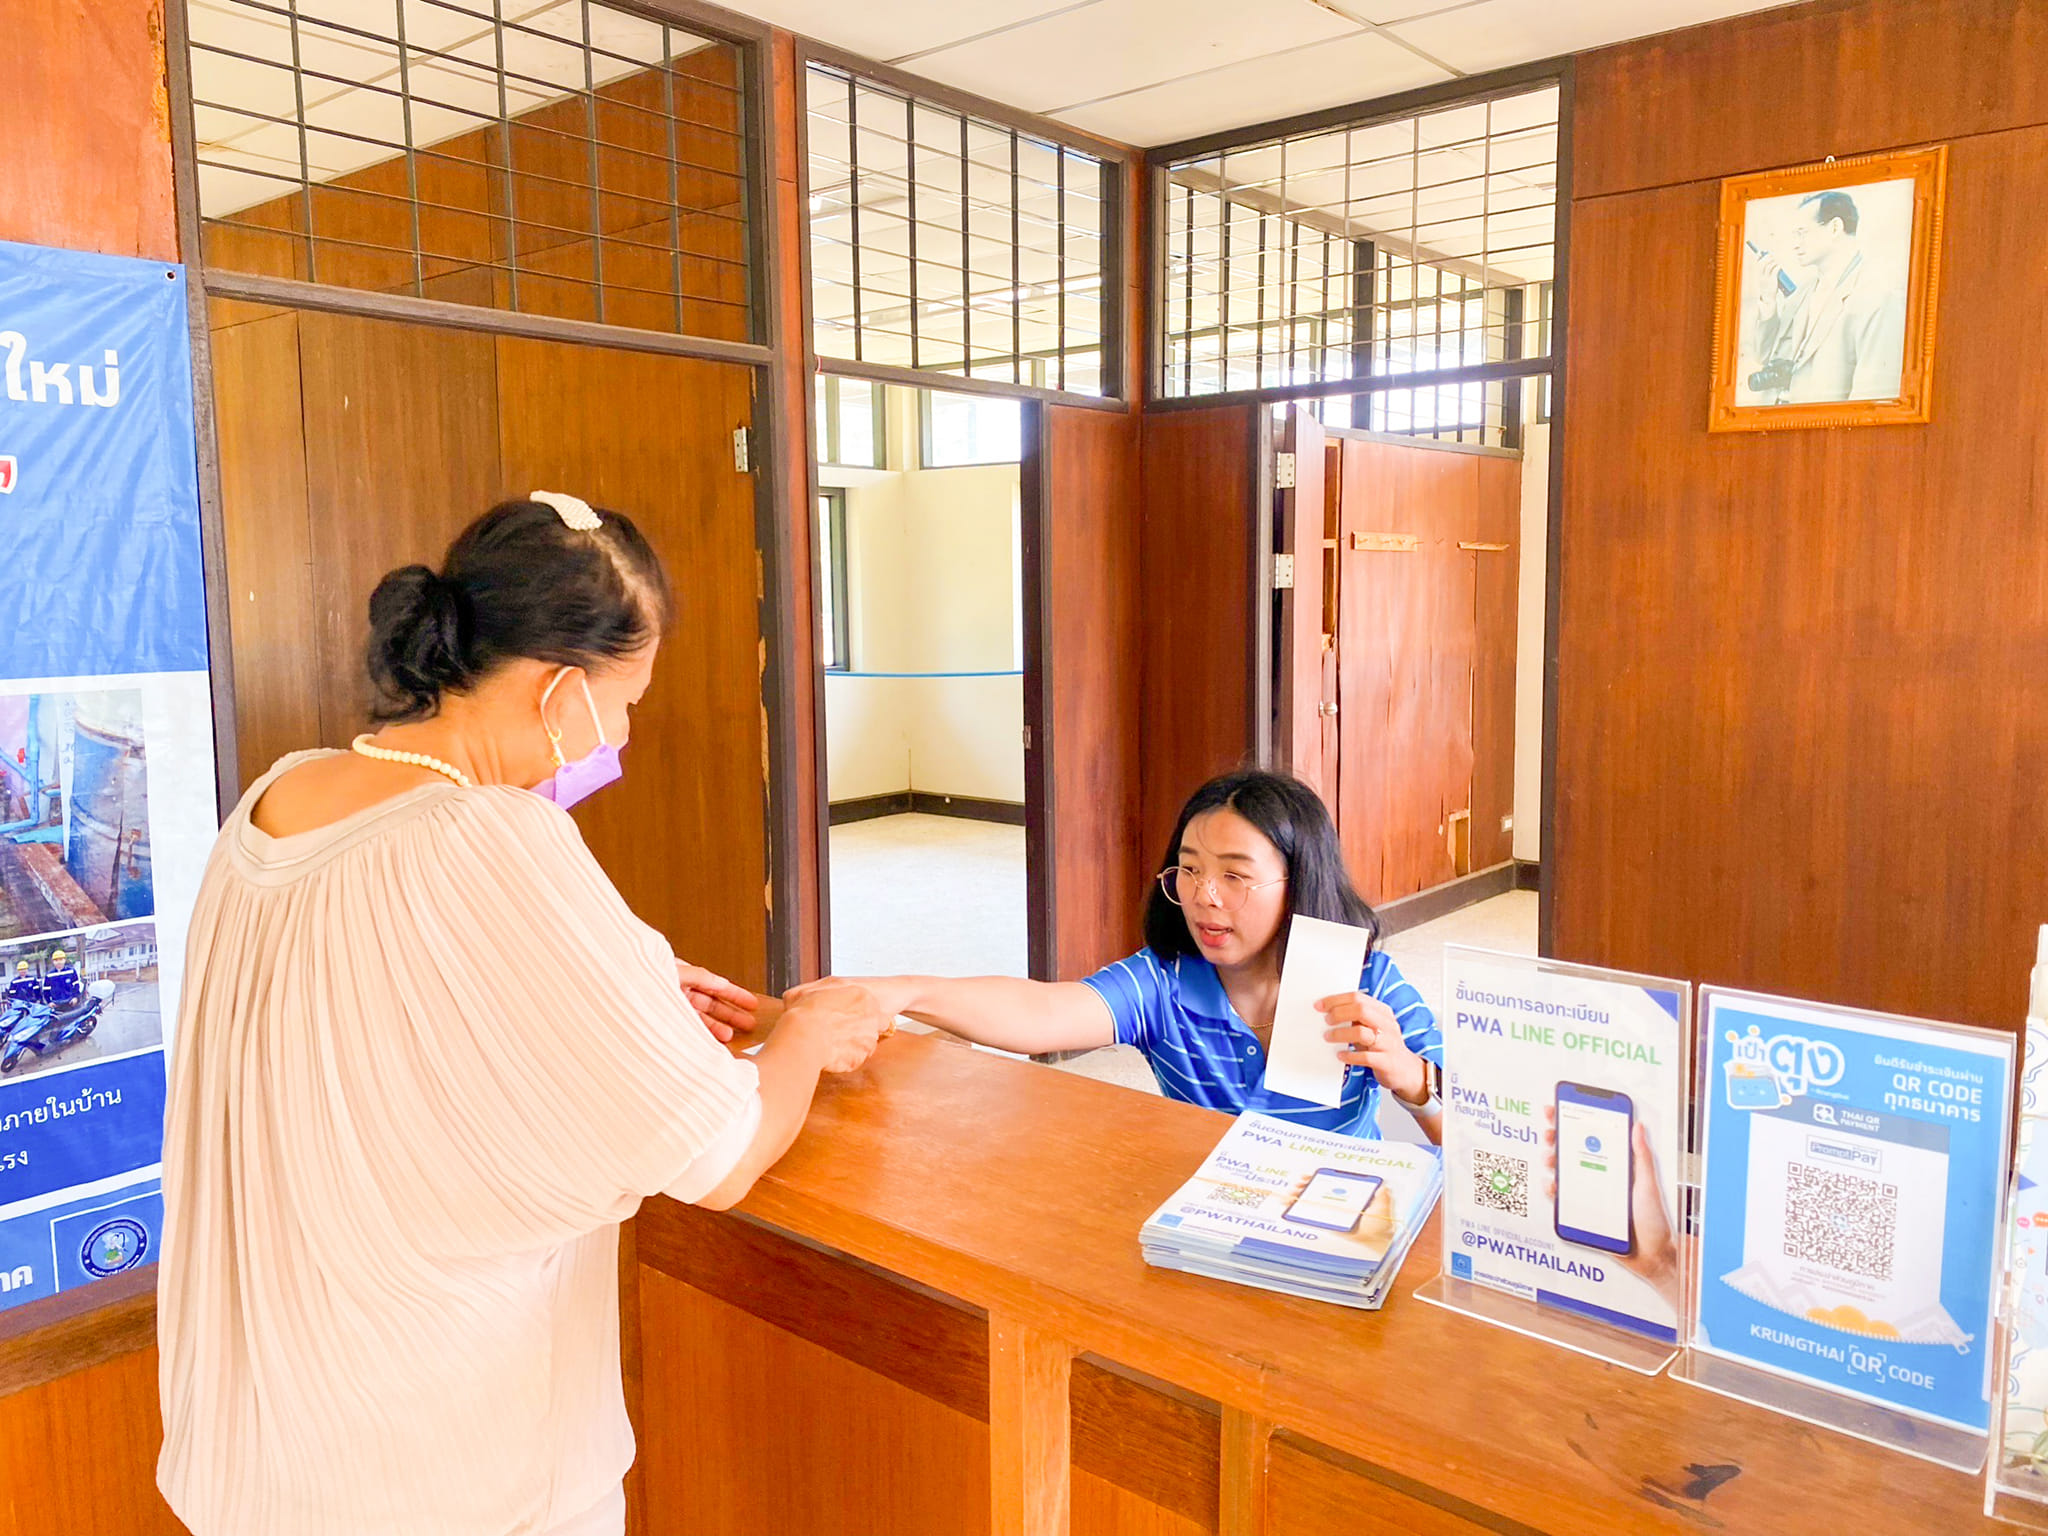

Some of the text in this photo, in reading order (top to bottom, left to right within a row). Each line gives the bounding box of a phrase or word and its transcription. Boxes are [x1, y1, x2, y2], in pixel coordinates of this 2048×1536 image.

[0, 331, 120, 408] ใหม่
[1456, 981, 1609, 1024] ขั้นตอนการลงทะเบียน
[1457, 1012, 1662, 1065] PWA LINE OFFICIAL
[1451, 1086, 1531, 1116] PWA LINE
[1893, 1073, 1983, 1105] QR CODE
[0, 1088, 121, 1132] ภายในบ้าน
[1841, 1110, 1880, 1125] THAI QR
[1884, 1092, 1981, 1122] ทุกธนาคาร
[1491, 1119, 1537, 1144] ประปา
[1840, 1119, 1880, 1132] PAYMENT
[0, 1150, 28, 1172] รง
[1216, 1156, 1250, 1169] PWA
[1255, 1165, 1289, 1177] LINE
[1241, 1130, 1416, 1170] PWA LINE OFFICIAL
[1180, 1205, 1319, 1241] @PWATHAILAND
[1461, 1231, 1605, 1282] @PWATHAILAND
[1750, 1324, 1935, 1390] KRUNGTHAI QR CODE
